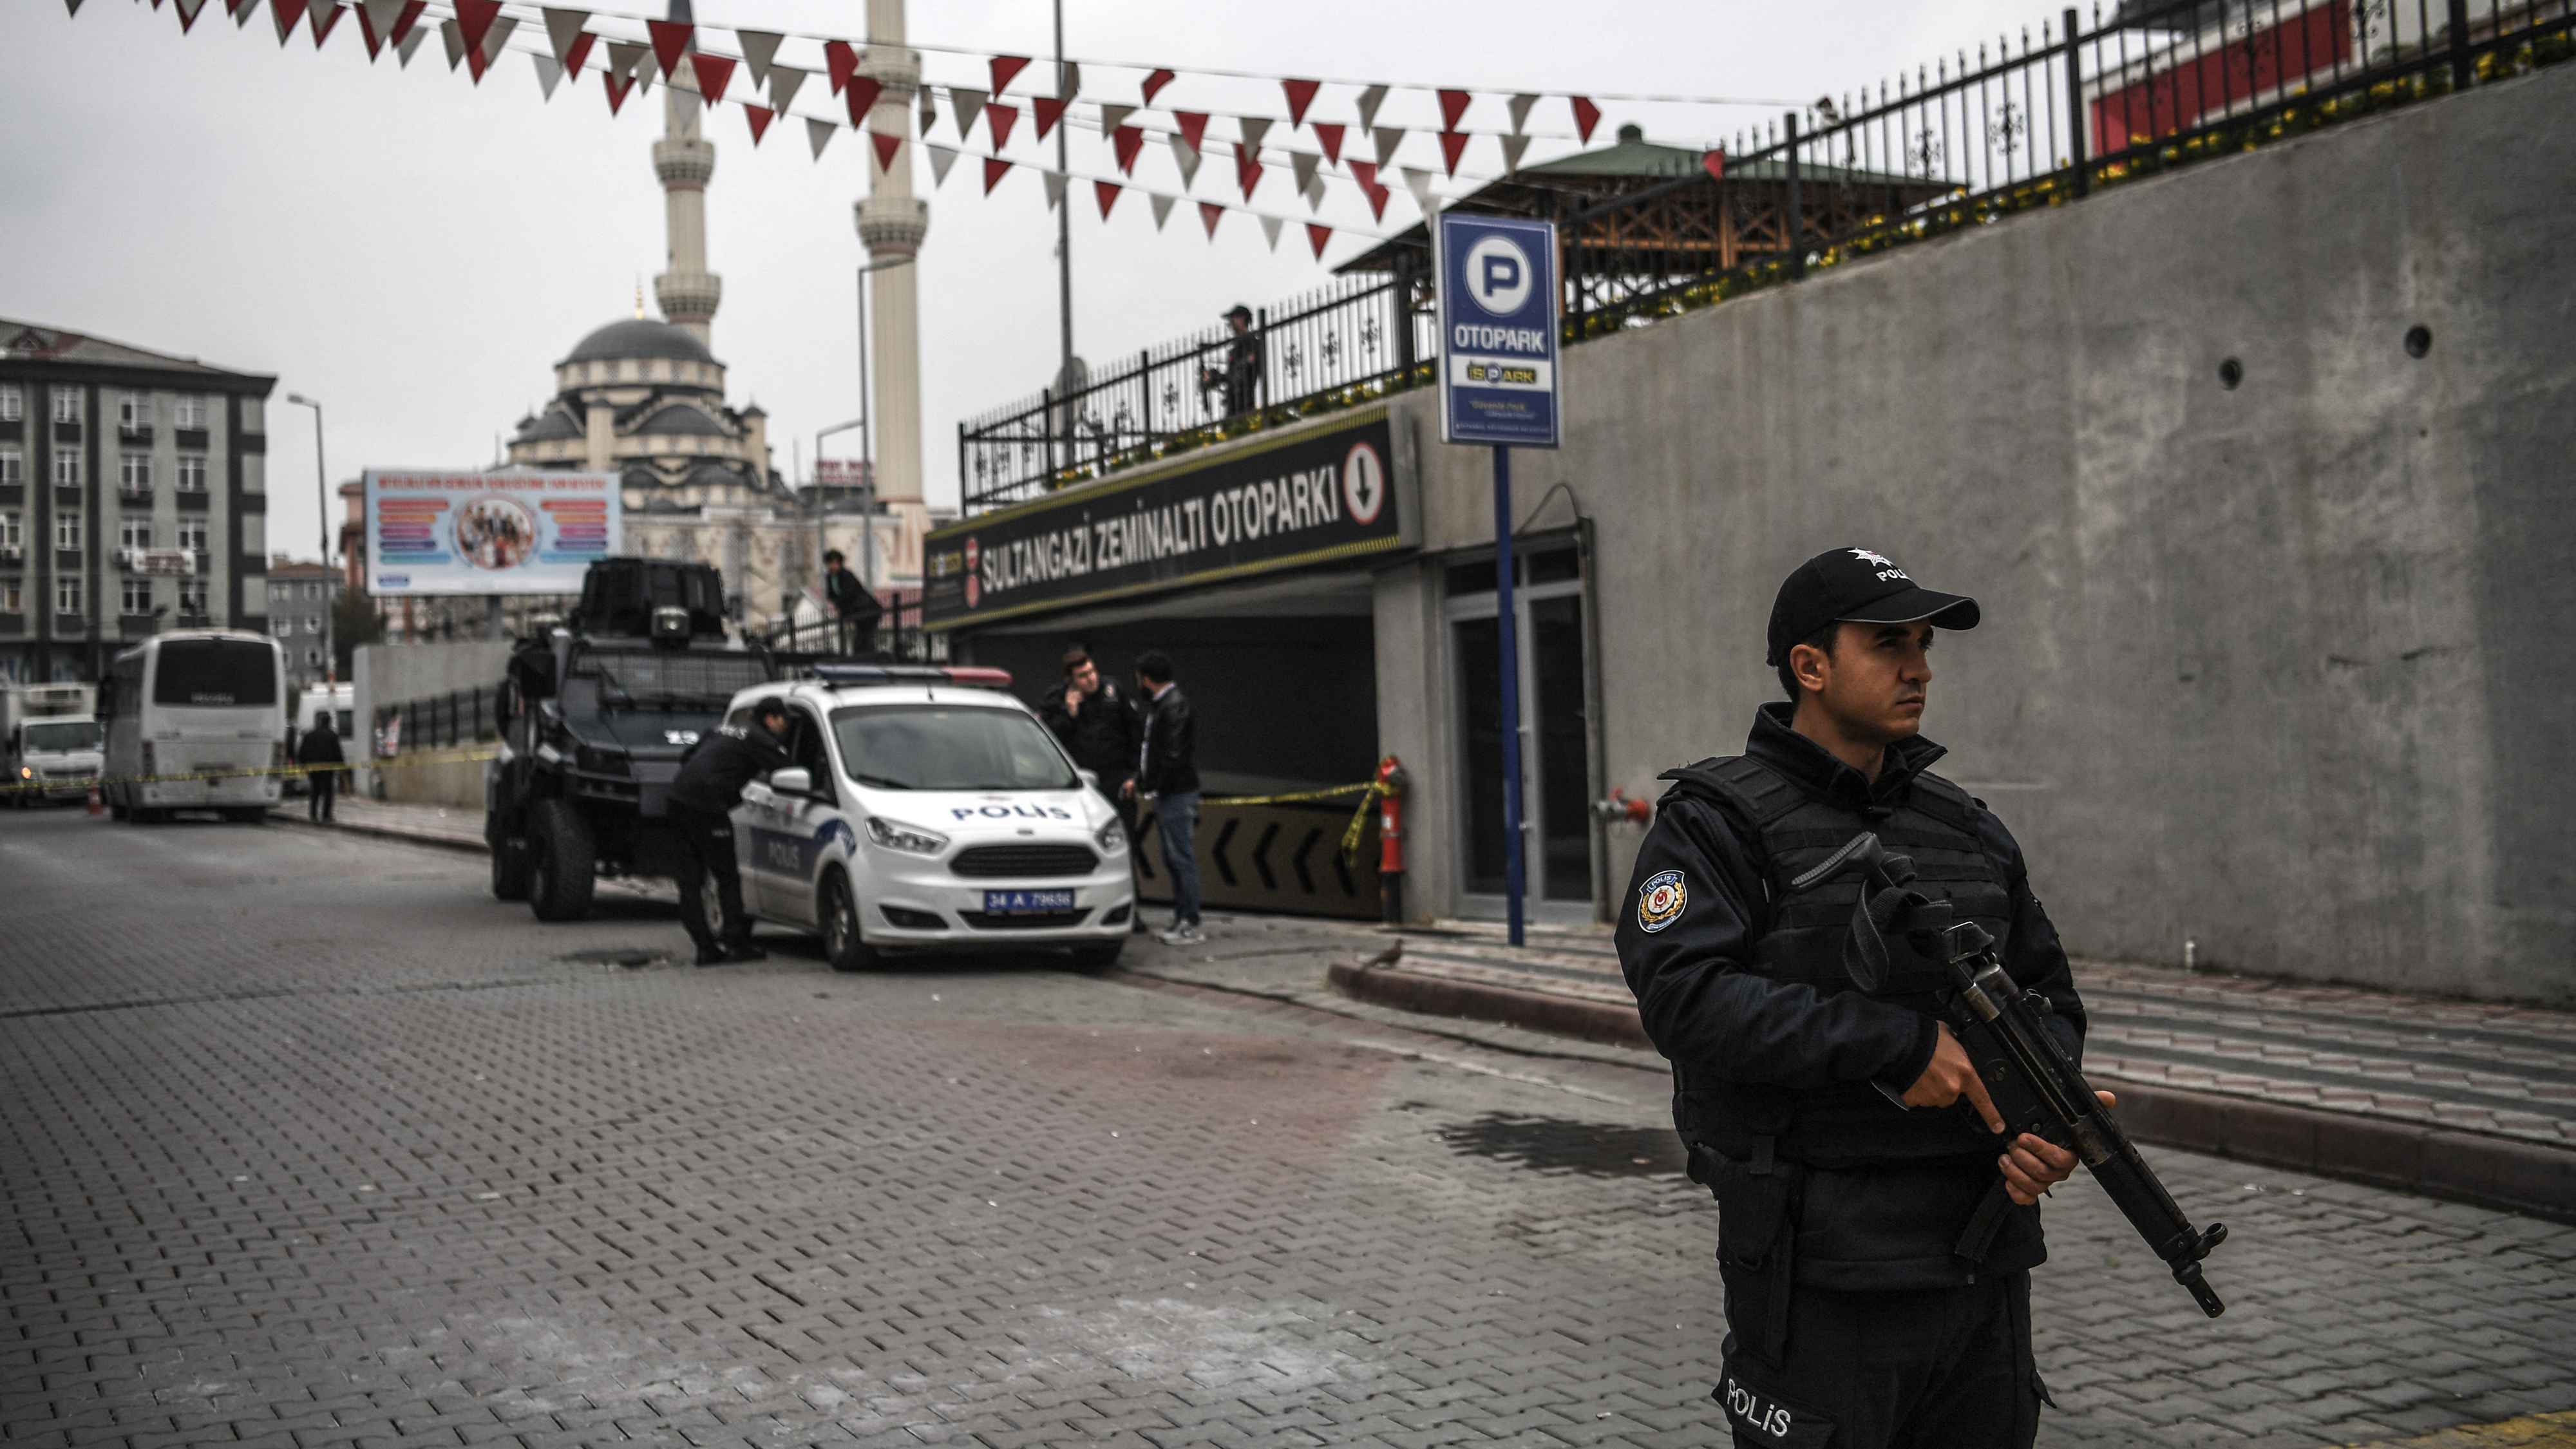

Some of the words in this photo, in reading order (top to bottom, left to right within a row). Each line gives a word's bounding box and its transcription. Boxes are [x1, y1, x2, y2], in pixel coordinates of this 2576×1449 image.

[1482, 256, 1520, 297] P
[1454, 325, 1544, 353] OTOPARK
[981, 512, 1092, 593] SULTANGAZİ
[1095, 497, 1206, 571] ZEMİNALTI
[1211, 465, 1340, 547] OTOPARKI
